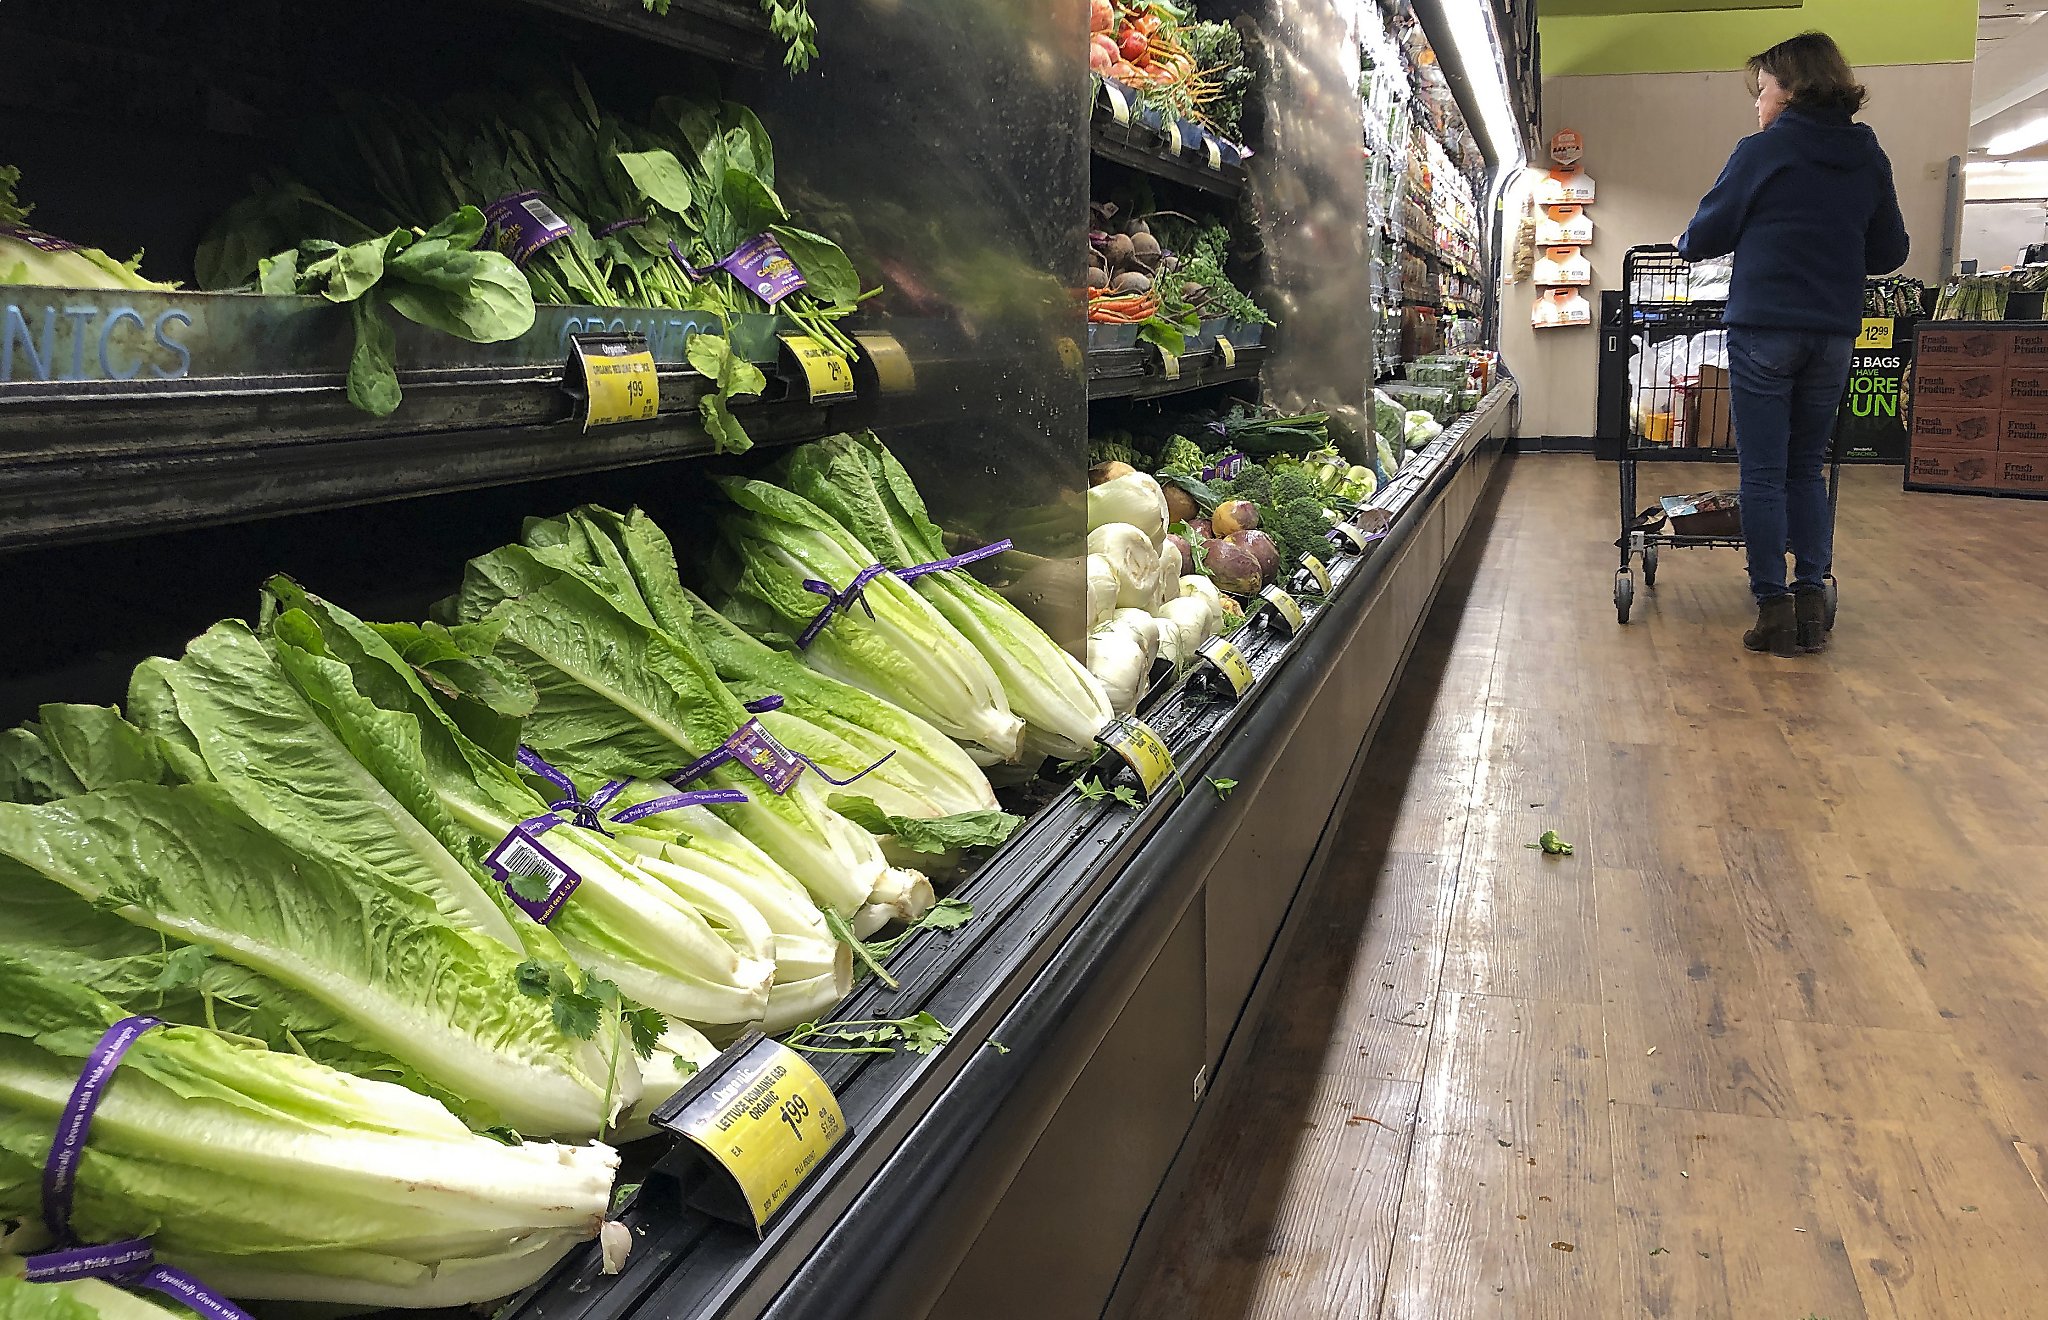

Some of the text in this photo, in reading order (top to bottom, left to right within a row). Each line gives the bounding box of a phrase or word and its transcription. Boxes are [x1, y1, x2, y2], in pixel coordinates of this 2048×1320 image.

[1921, 335, 1948, 344] Fresh
[2014, 336, 2043, 345] Fresh
[1921, 344, 1959, 353] Produce
[1863, 356, 1900, 368] BAGS
[1918, 377, 1944, 385] Fresh
[2011, 378, 2040, 388] Fresh
[1918, 386, 1955, 395] Produce
[1850, 394, 1897, 417] UN
[1916, 417, 1942, 426] Fresh
[2008, 420, 2036, 430] Fresh
[1916, 426, 1952, 435] Produce
[1914, 457, 1940, 466] Fresh
[1913, 466, 1949, 476] Produce
[2005, 463, 2033, 473] Fresh
[2004, 472, 2044, 482] Produce
[537, 902, 555, 925] Produit
[553, 894, 564, 908] des
[101, 1049, 116, 1066] and
[84, 1065, 105, 1089] Pride
[78, 1090, 93, 1112] with
[715, 1065, 788, 1132] LETTUCE ROMAINE RED
[748, 1091, 780, 1121] ORGANIC
[780, 1094, 809, 1142] 199
[65, 1112, 84, 1146] Grown
[731, 1145, 743, 1158] EA
[83, 1256, 112, 1274] Pride
[156, 1270, 196, 1296] Organically
[195, 1291, 222, 1311] Grown
